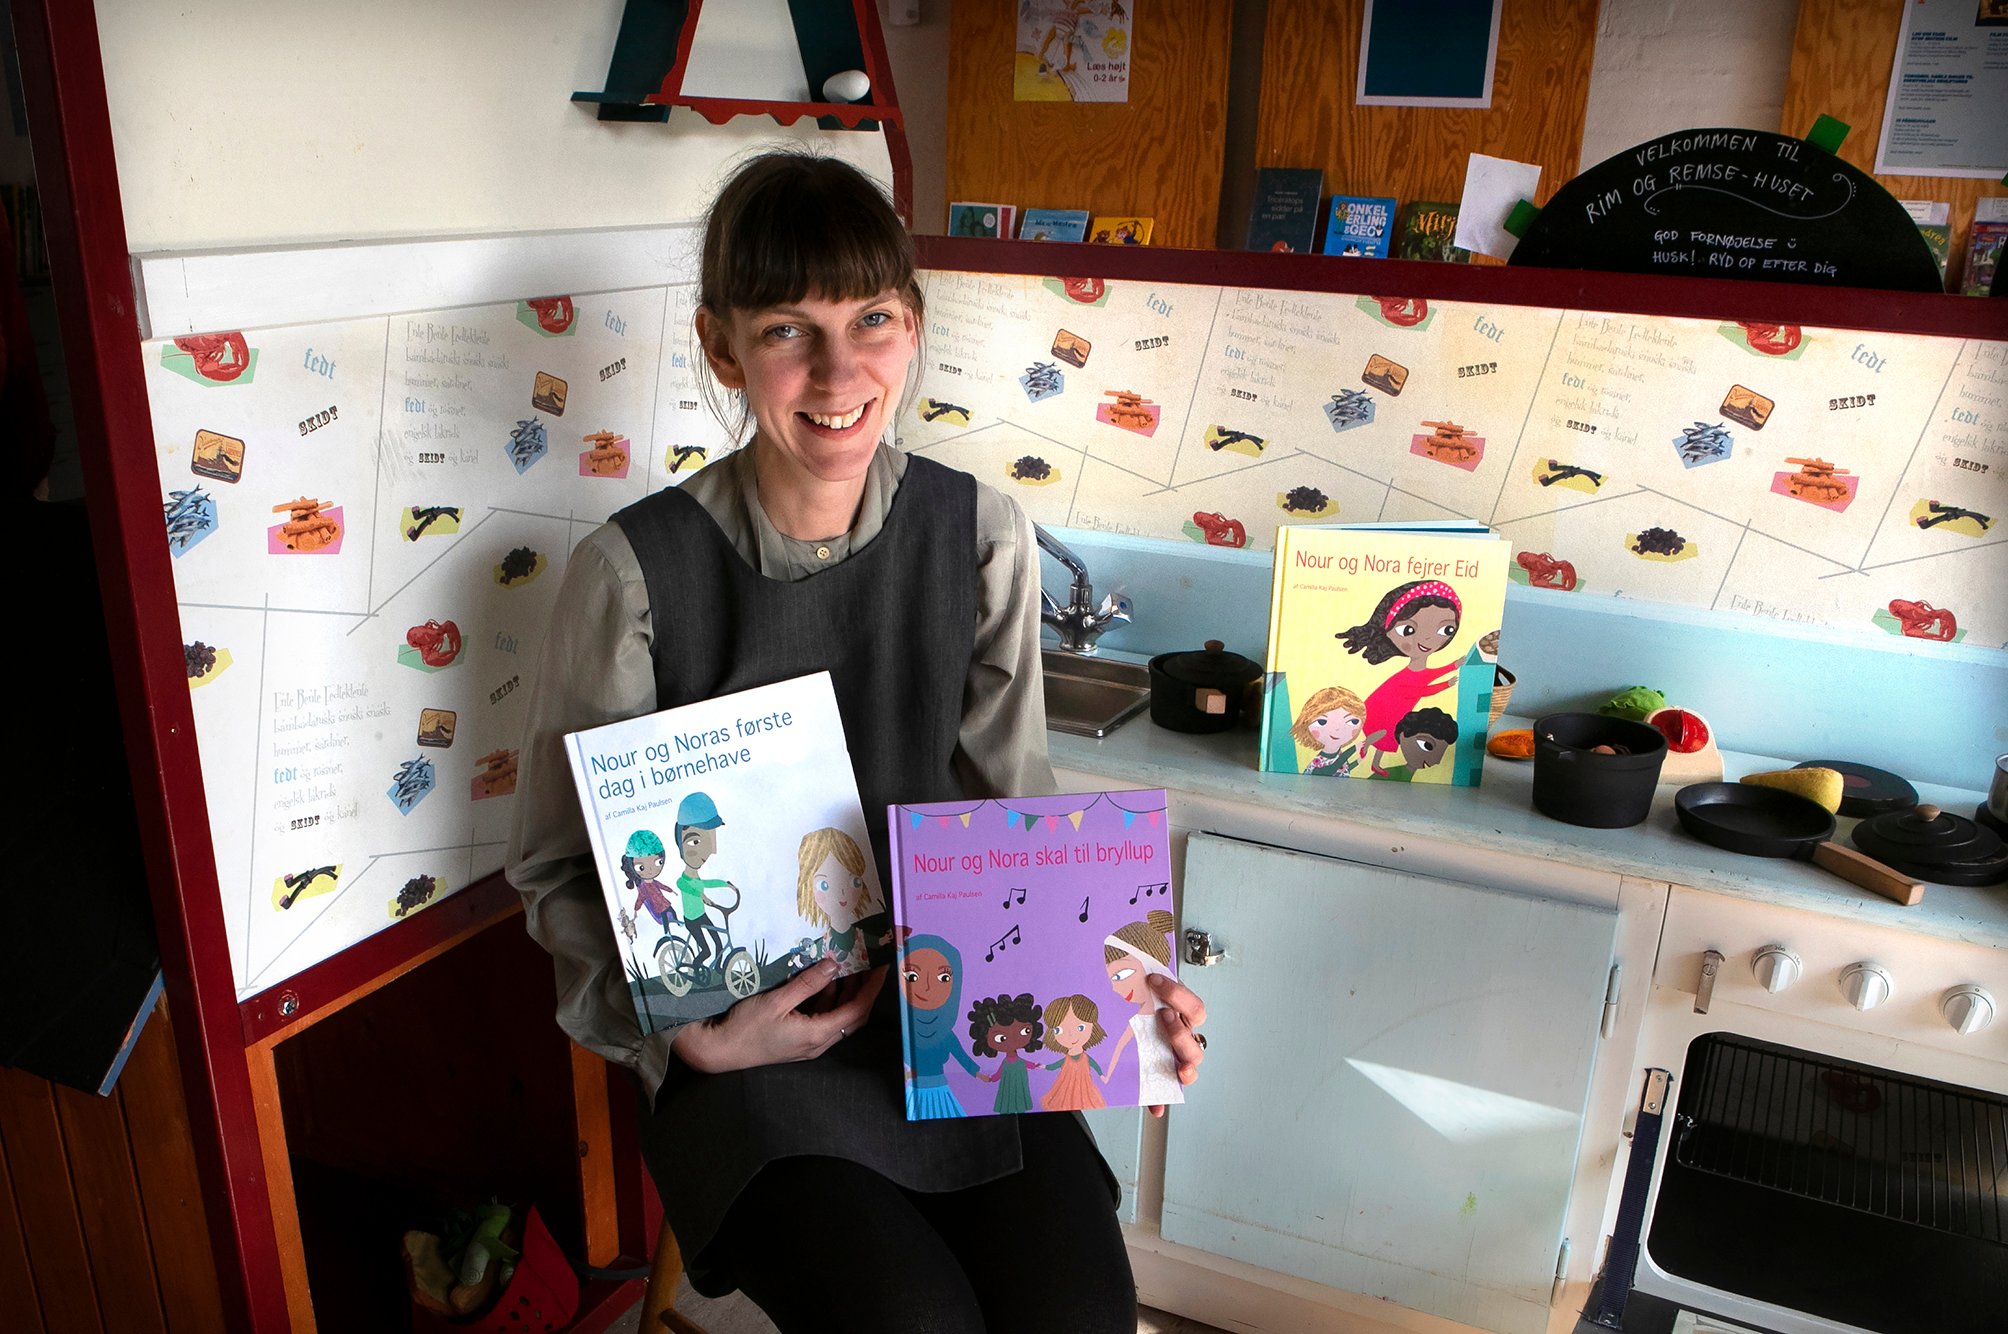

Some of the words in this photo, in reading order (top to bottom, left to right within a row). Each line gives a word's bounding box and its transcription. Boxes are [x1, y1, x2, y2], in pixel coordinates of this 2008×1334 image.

[1087, 62, 1106, 71] Læs
[1108, 61, 1126, 73] højt
[1093, 74, 1107, 82] 0-2
[1108, 73, 1118, 82] år
[1636, 133, 1758, 167] VELKOMMEN
[1633, 174, 1656, 196] OG
[1348, 203, 1388, 217] ONKEL
[1345, 214, 1387, 229] ERLING
[1653, 229, 1679, 245] GOD
[1690, 231, 1778, 250] FORNØJELSE
[1652, 250, 1696, 266] HUSK!
[1709, 252, 1734, 269] RYD
[1739, 256, 1757, 270] OP
[1762, 258, 1807, 273] EFTER
[1146, 293, 1174, 318] fedt
[605, 309, 628, 337] fedt
[932, 323, 950, 337] fedt
[1473, 315, 1504, 343] fedt
[1134, 335, 1169, 351] SKIDT
[1224, 345, 1246, 361] fedt
[1851, 343, 1887, 373] fedt
[303, 348, 337, 380] fedt
[599, 358, 627, 382] SKIDT
[939, 363, 963, 376] SKIDT
[1458, 362, 1498, 378] SKIDT
[1561, 372, 1586, 391] fedt
[405, 396, 426, 413] fedt
[1230, 388, 1258, 402] SKIDT
[1829, 394, 1876, 411] SKIDT
[679, 400, 698, 410] SKIDT
[298, 405, 338, 437] SKIDT
[1951, 407, 1979, 426] fedt
[1566, 419, 1597, 435] SKIDT
[418, 452, 445, 464] SKIDT
[1953, 457, 1989, 474] SKIDT
[1295, 550, 1333, 570] Nour
[1338, 556, 1359, 576] og
[1364, 554, 1401, 573] Nora
[1407, 556, 1450, 579] fejrer
[1455, 559, 1479, 578] Eid
[495, 631, 519, 655] fedt
[489, 675, 520, 705] SKIDT
[591, 750, 638, 775] Nour
[645, 742, 670, 763] og
[674, 727, 731, 753] Noras
[735, 711, 793, 738] første
[273, 766, 298, 784] fedt
[599, 778, 634, 800] dag
[639, 770, 646, 789] i
[650, 748, 751, 786] børnehave
[604, 812, 611, 821] af
[612, 807, 636, 819] Camilla
[636, 803, 648, 813] Kaj
[648, 797, 673, 810] Paulsen
[290, 814, 321, 830] SKIDT
[914, 853, 956, 873] Nour
[961, 855, 983, 875] og
[989, 848, 1029, 869] Nora
[1035, 844, 1068, 865] skal
[1074, 842, 1090, 863] til
[1096, 840, 1154, 865] bryllup
[915, 893, 923, 901] af
[923, 892, 946, 901] Camilla
[947, 891, 958, 901] Kaj
[958, 890, 983, 899] Paulsen
